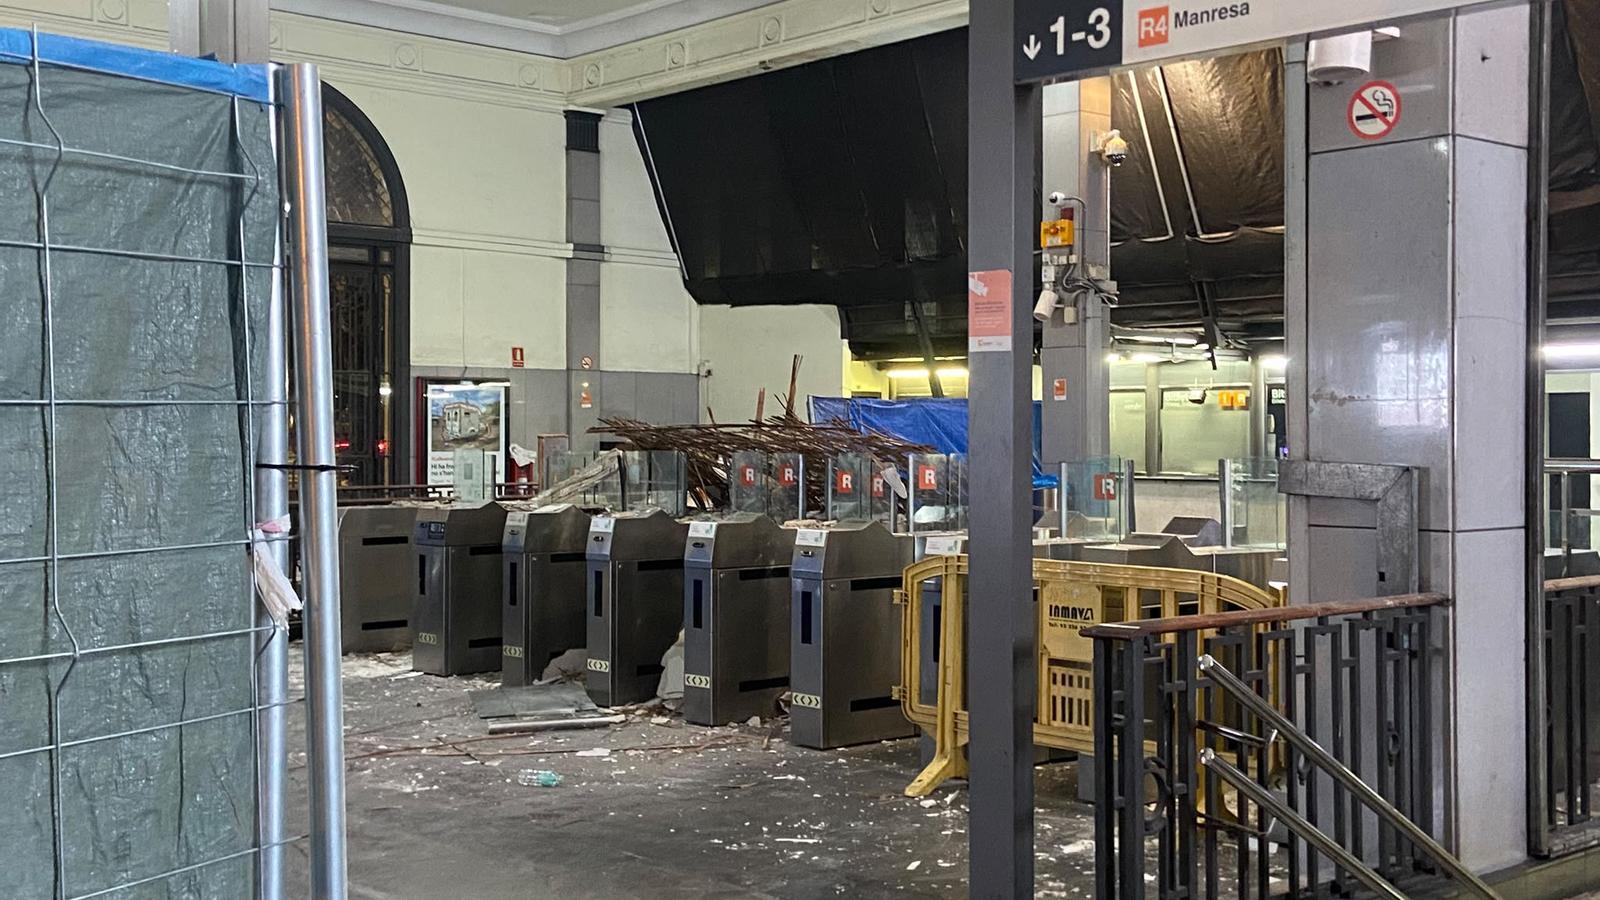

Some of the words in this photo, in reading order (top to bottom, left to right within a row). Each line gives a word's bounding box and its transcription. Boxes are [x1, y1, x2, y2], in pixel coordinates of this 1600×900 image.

[1140, 14, 1168, 40] R4
[1174, 2, 1250, 29] Manresa
[1049, 7, 1111, 56] 1-3
[745, 468, 754, 481] R
[784, 468, 794, 481] R
[842, 474, 852, 488] R
[925, 469, 936, 484] R
[1102, 479, 1115, 495] R
